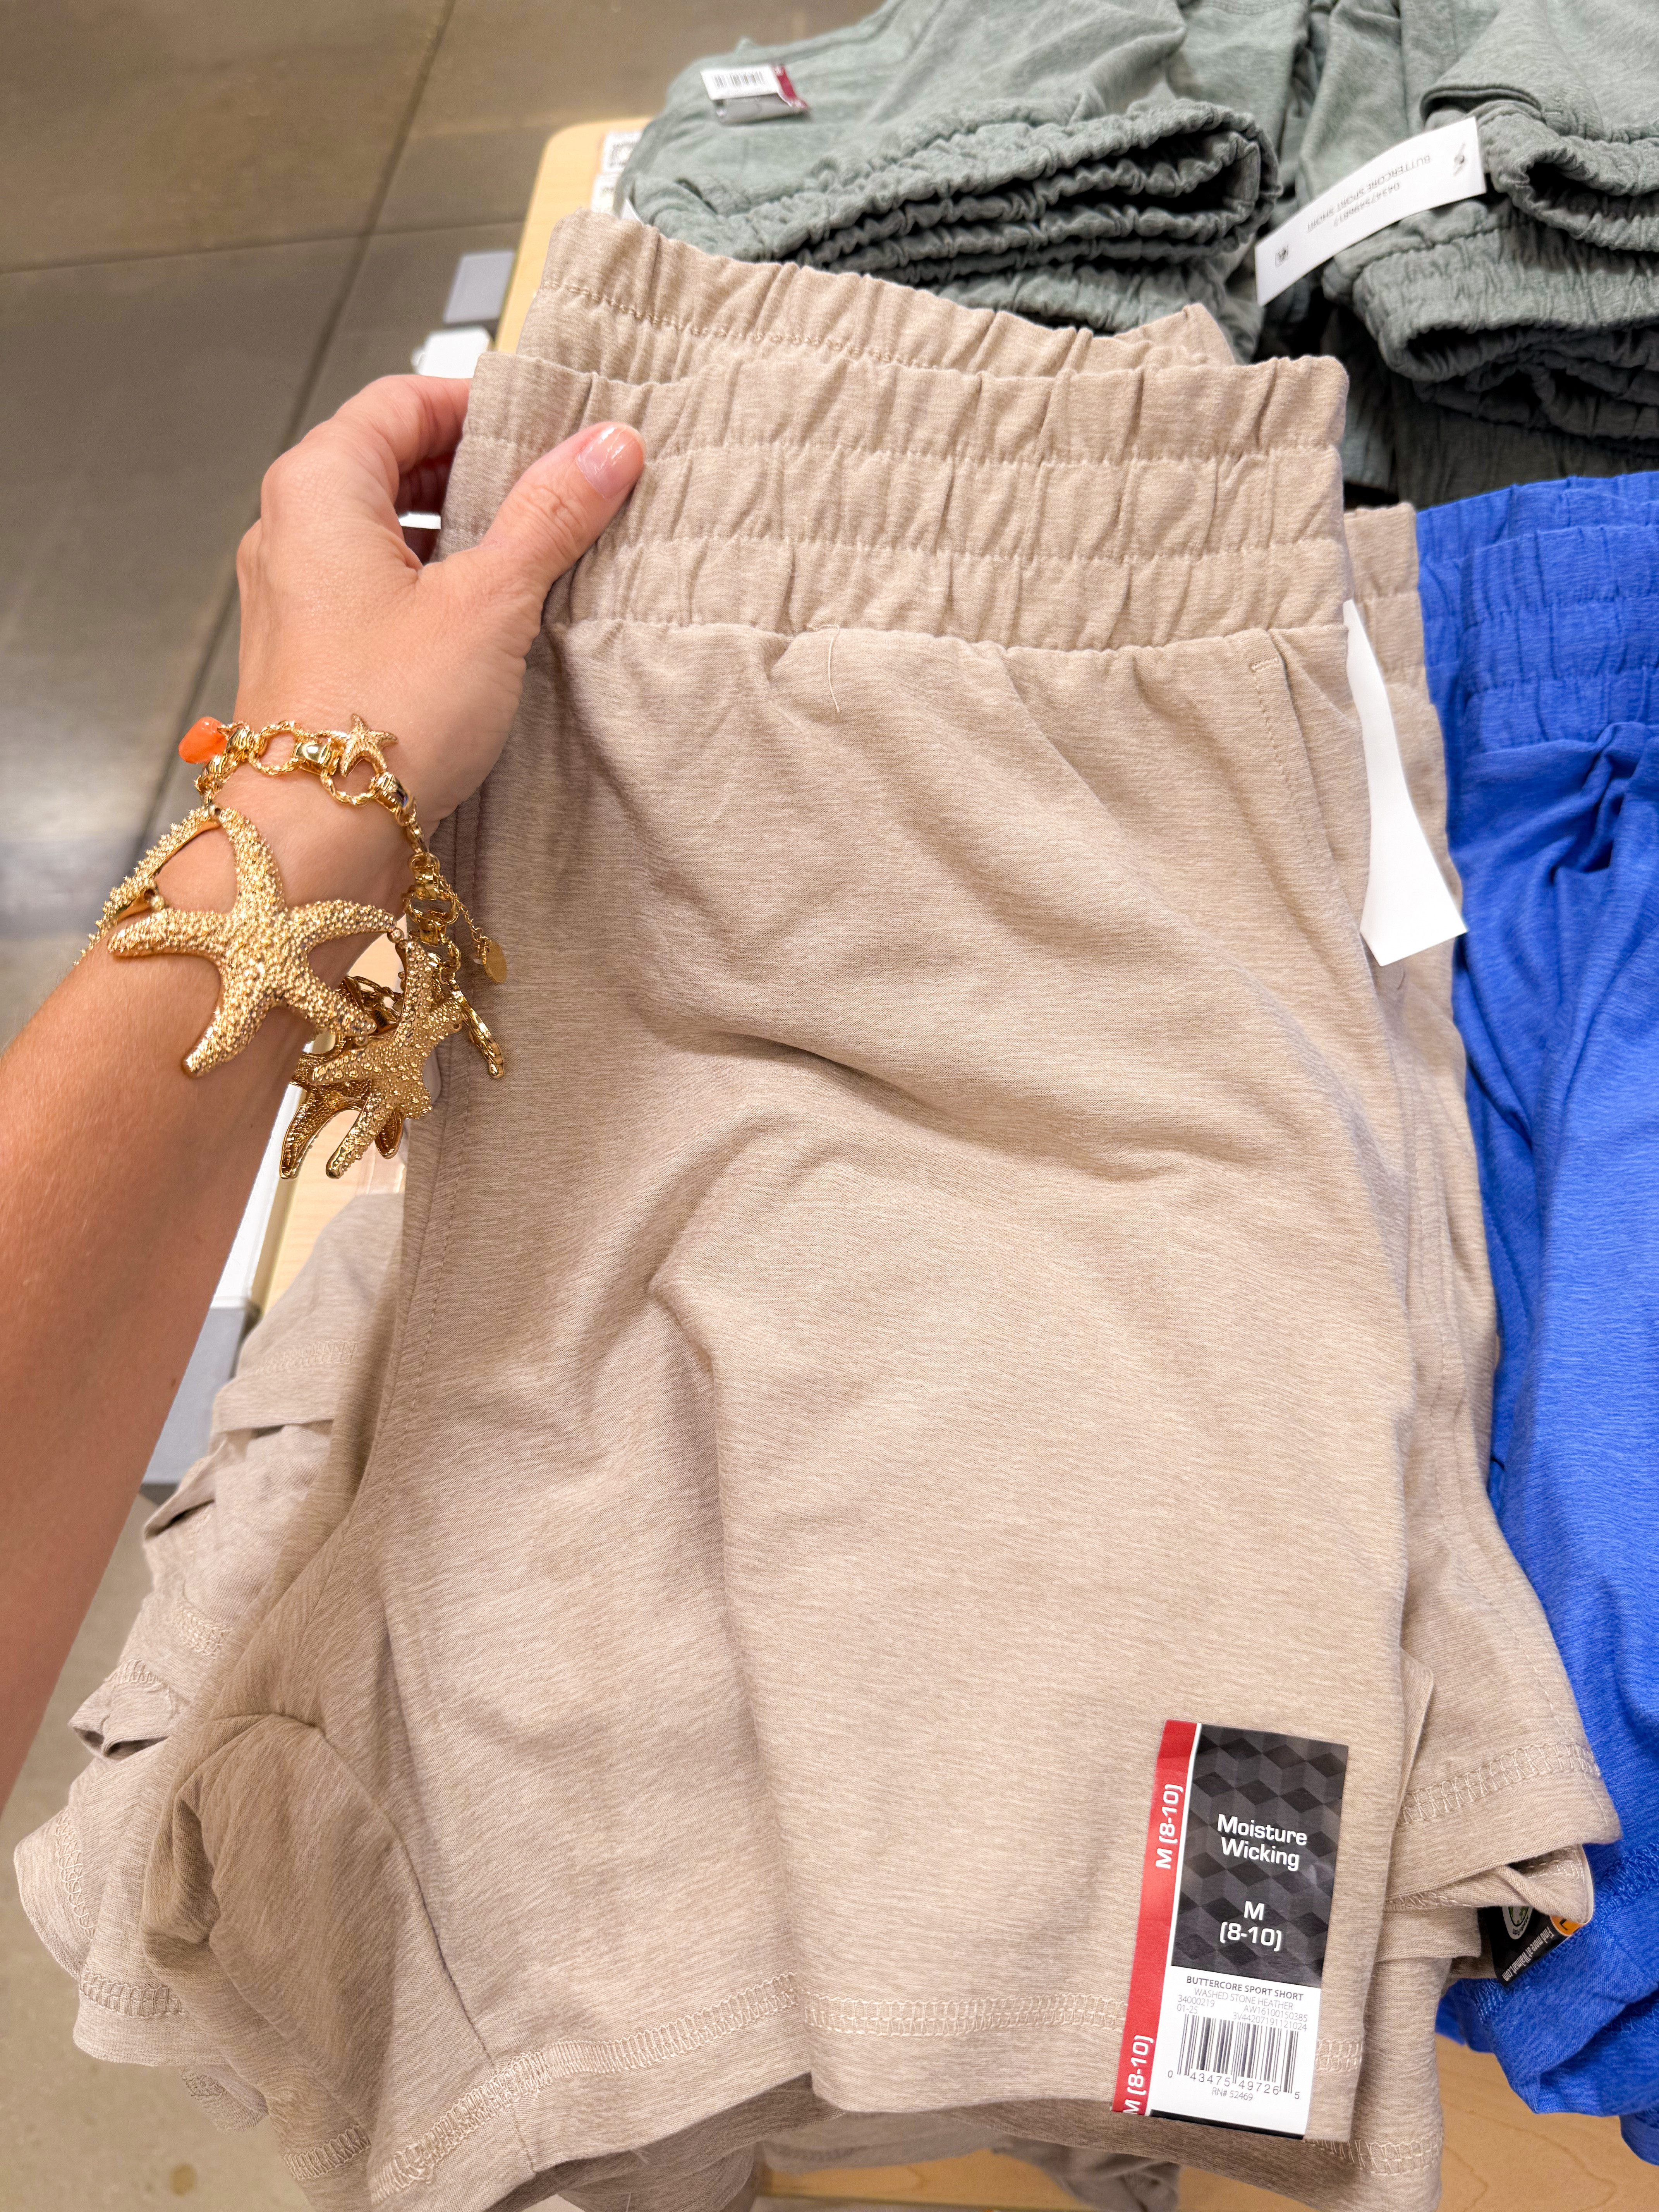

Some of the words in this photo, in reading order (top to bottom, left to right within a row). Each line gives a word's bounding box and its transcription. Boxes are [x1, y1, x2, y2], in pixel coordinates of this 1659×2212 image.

[1366, 154, 1431, 191] BUTTERCORE
[1336, 188, 1364, 212] SPORT
[1307, 208, 1335, 233] SHORT
[1159, 1784, 1183, 1844] (8-10)
[1218, 1814, 1307, 1845] Moisture
[1156, 1848, 1172, 1869] M
[1221, 1837, 1299, 1871] Wicking
[1244, 1901, 1264, 1920] M
[1220, 1922, 1281, 1951] (8-10)
[1530, 1935, 1544, 1952] more
[1540, 1926, 1554, 1944] Find
[1524, 1946, 1534, 1957] at
[1501, 1952, 1531, 1982] Walmart.com
[1187, 1976, 1242, 1991] BUTTERCORE
[1244, 1985, 1273, 1996] SPORT
[1274, 1990, 1304, 2001] SHORT
[1194, 1987, 1228, 2000] WASHED
[1230, 1994, 1255, 2004] STONE
[1257, 1998, 1293, 2010] HEATHER
[1177, 2004, 1198, 2014] 01-25
[1178, 1994, 1215, 2007] 34000219
[1232, 2012, 1307, 2031] 3V44207191121024
[1243, 2004, 1308, 2022] AW16100150385
[1127, 2035, 1154, 2095] (8-10)
[1190, 2072, 1230, 2087] 43475
[1238, 2080, 1279, 2095] 49726
[1212, 2087, 1227, 2096] RN#
[1230, 2090, 1253, 2101] 52469
